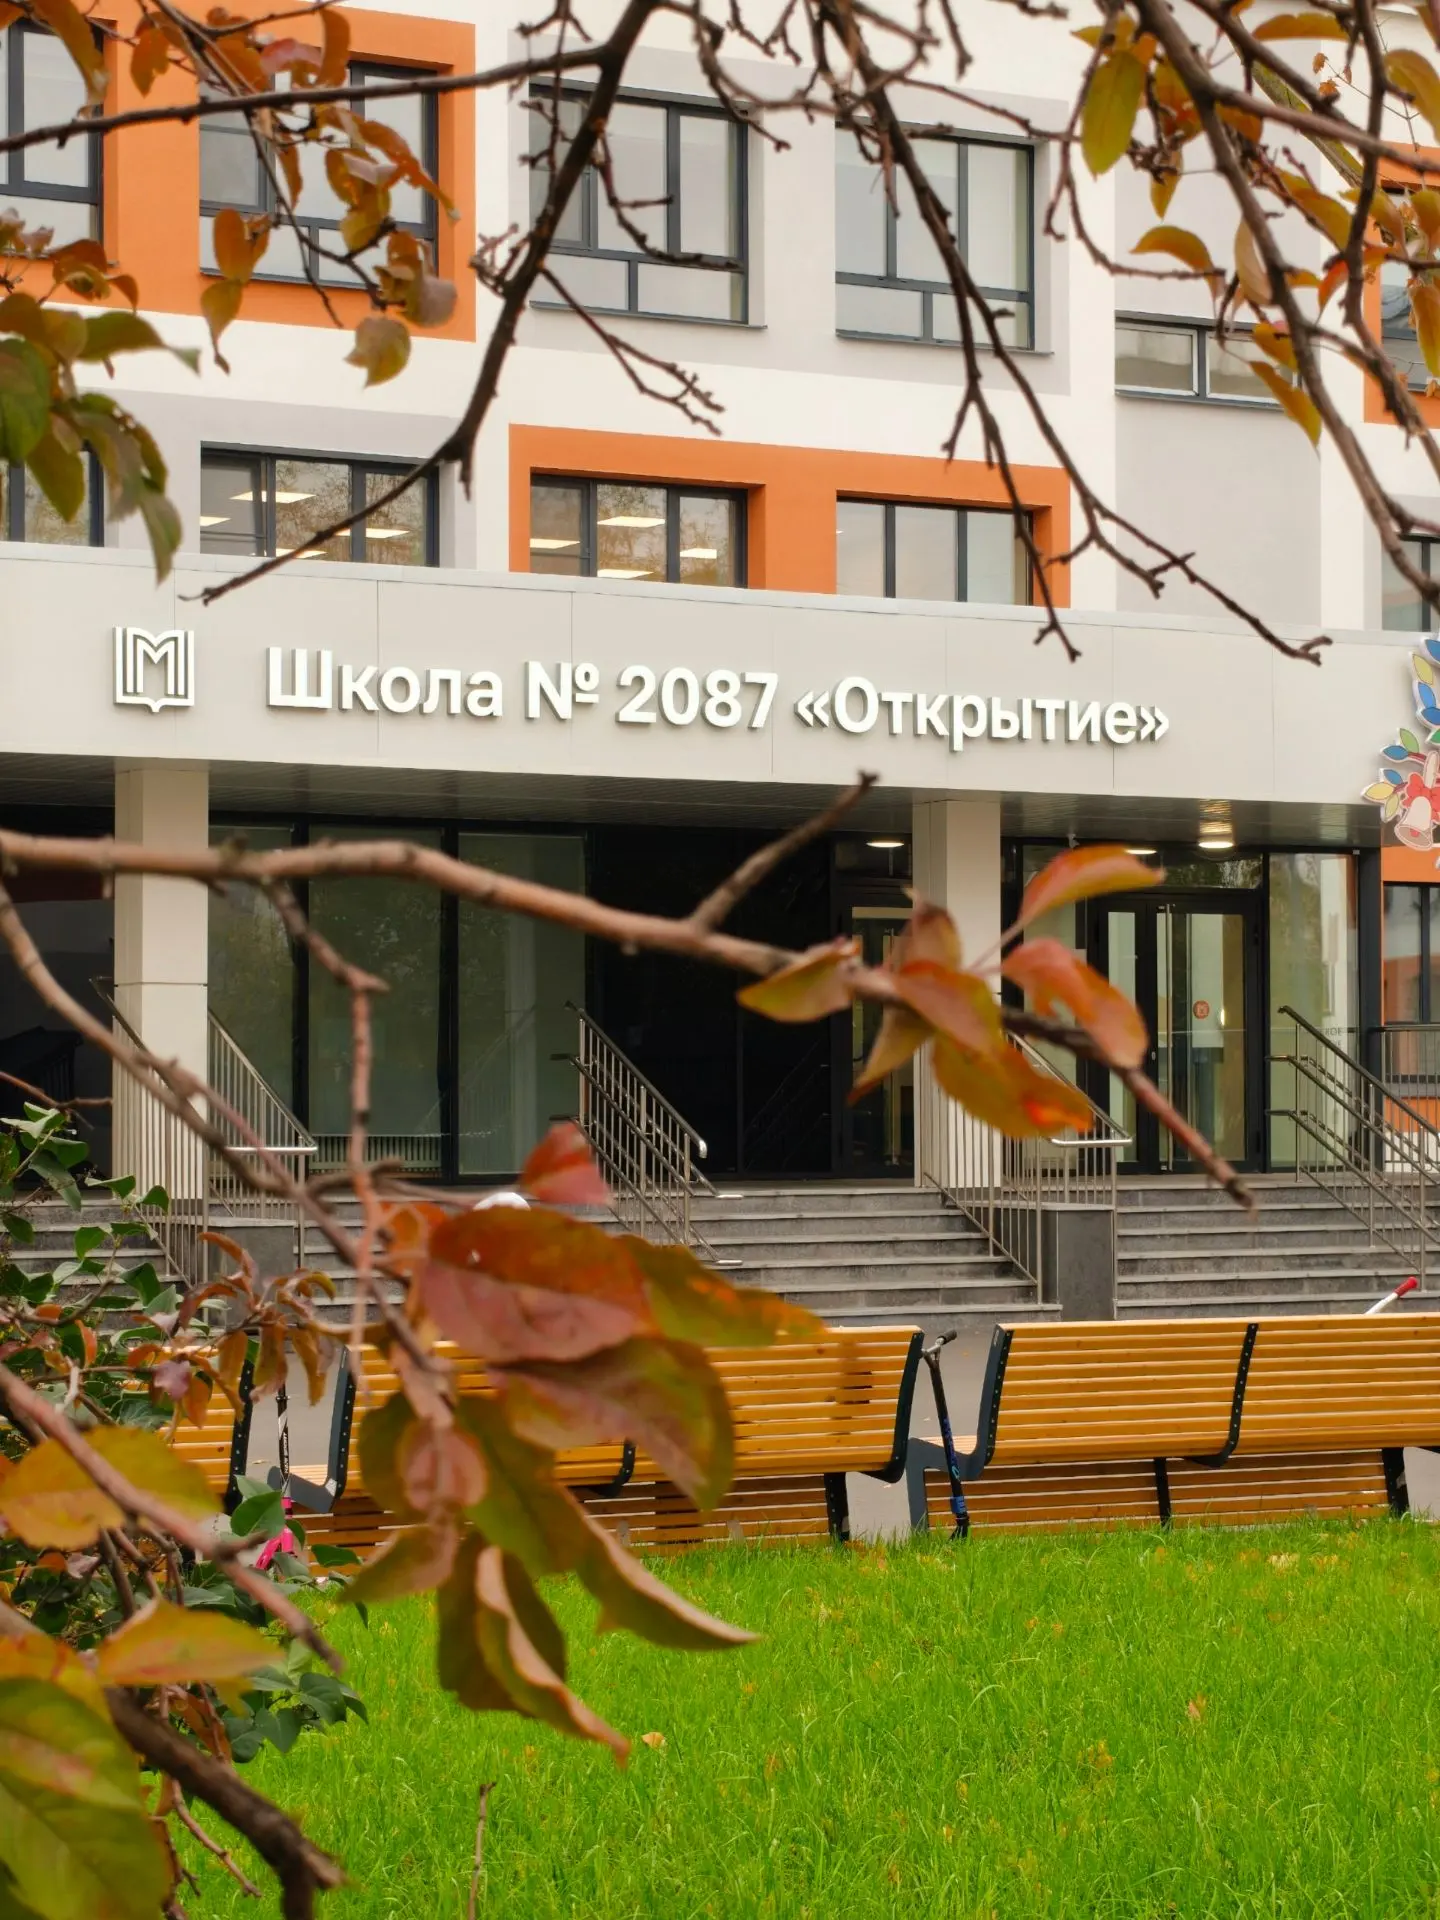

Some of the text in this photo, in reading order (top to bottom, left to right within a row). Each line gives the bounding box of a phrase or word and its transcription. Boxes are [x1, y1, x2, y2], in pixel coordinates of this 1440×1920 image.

[266, 648, 1170, 752] Школа № 2087 «Открытие»
